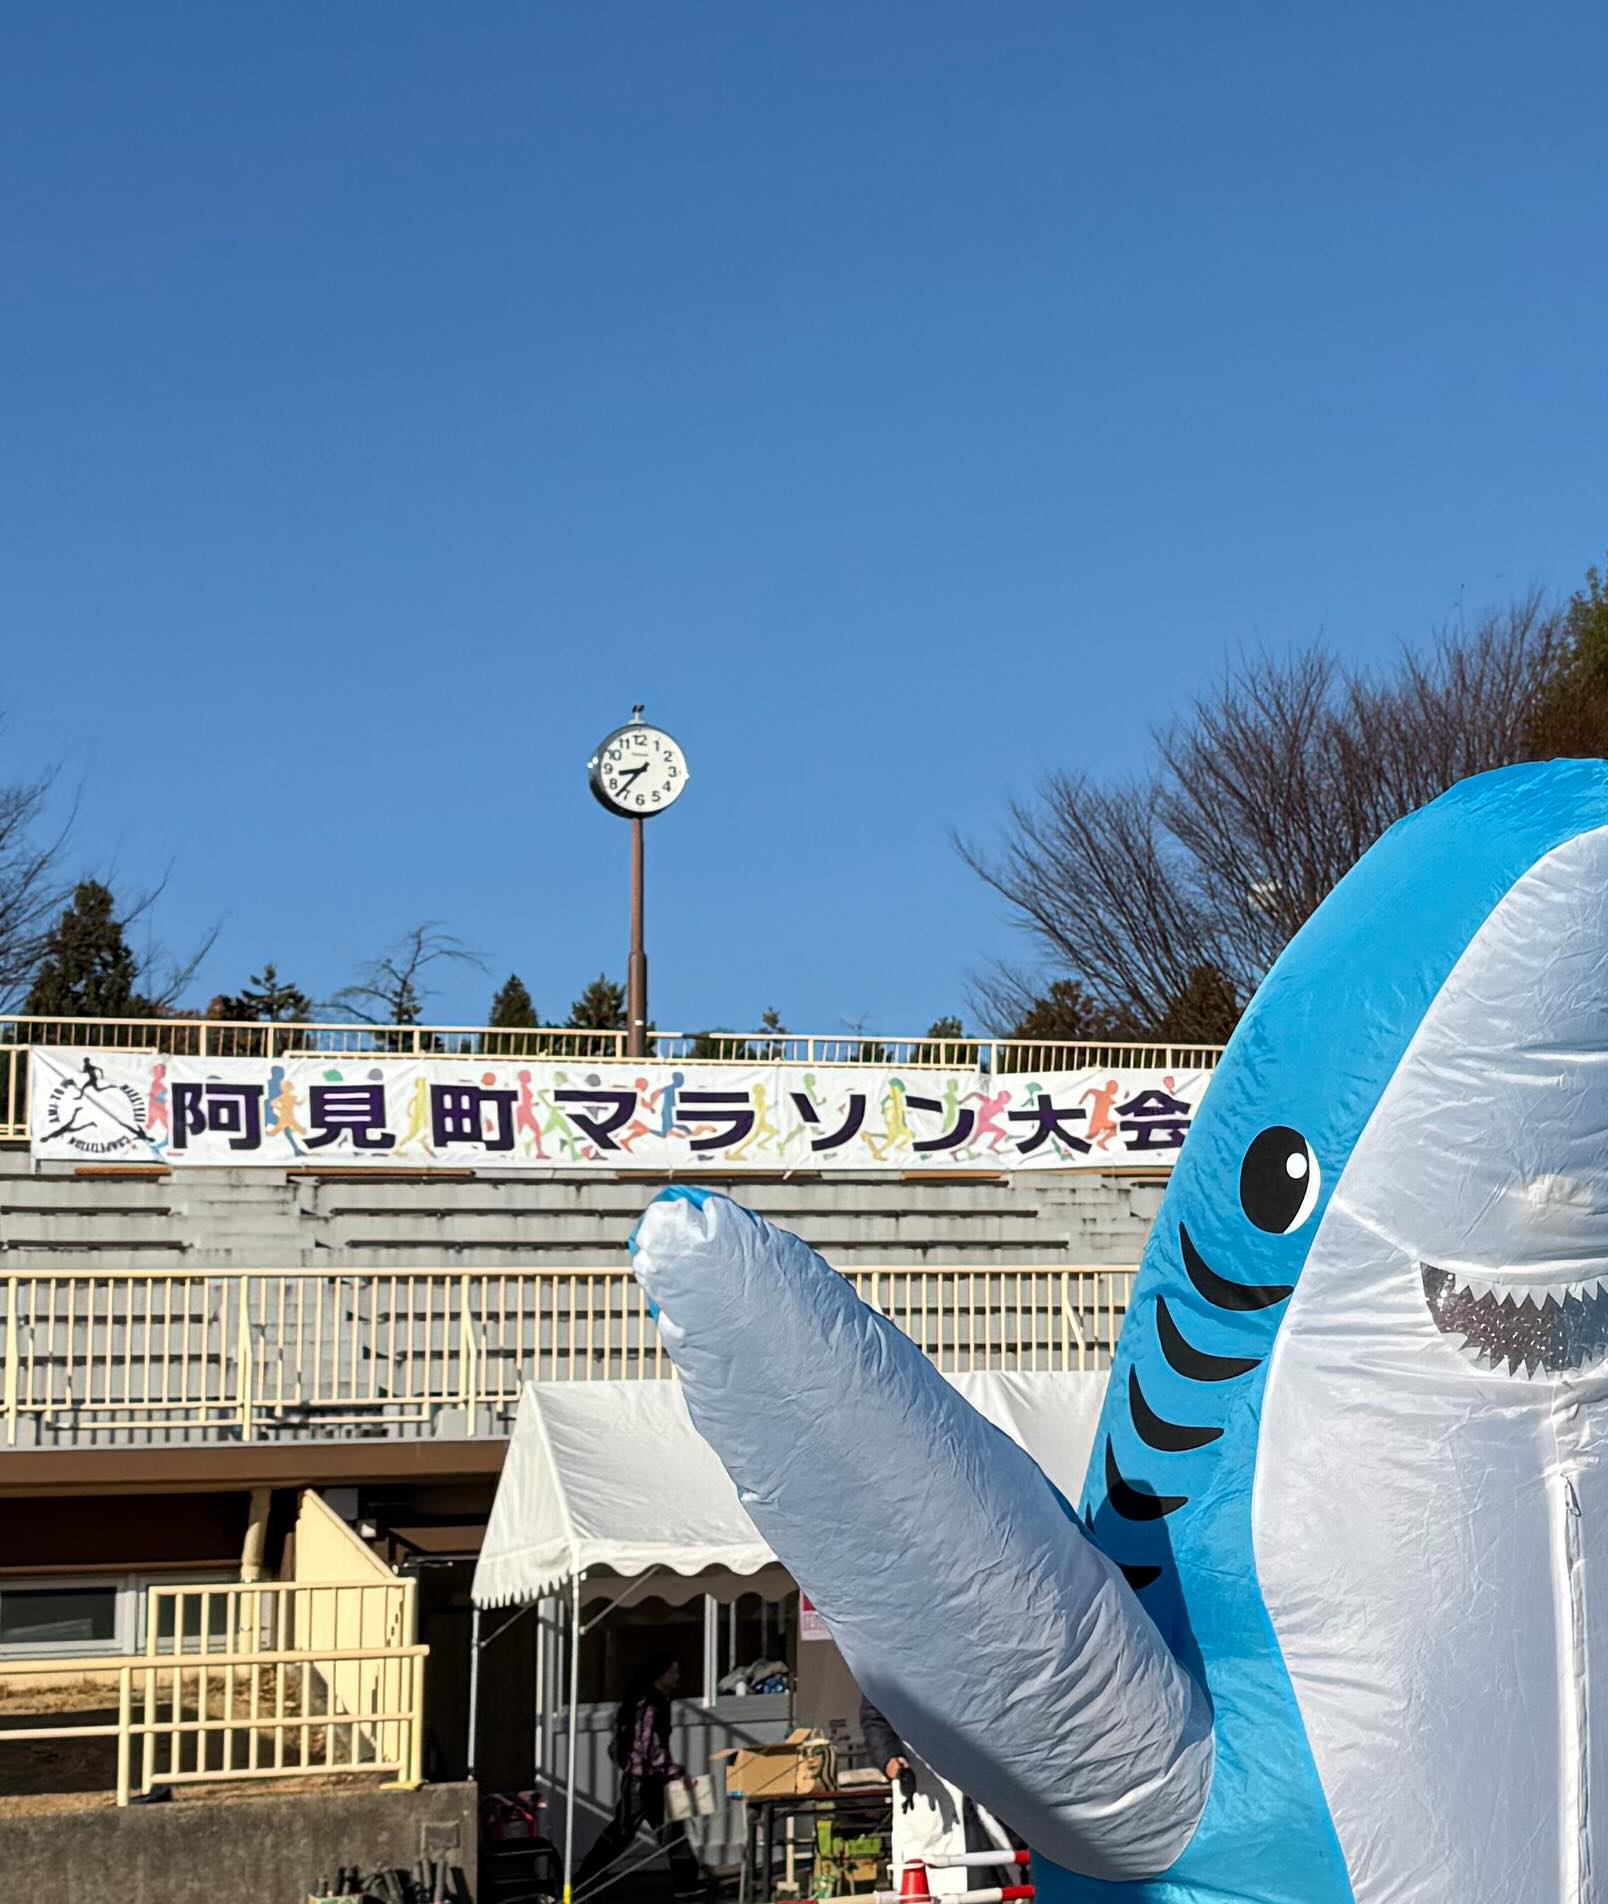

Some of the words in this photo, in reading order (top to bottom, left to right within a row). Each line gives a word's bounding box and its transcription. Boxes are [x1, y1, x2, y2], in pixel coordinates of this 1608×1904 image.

[619, 738, 630, 749] 11
[632, 734, 647, 746] 12
[654, 740, 660, 752] 1
[608, 749, 622, 761] 10
[663, 750, 673, 762] 2
[603, 762, 613, 774] 9
[668, 766, 677, 777] 3
[609, 778, 618, 790] 8
[662, 780, 671, 792] 4
[635, 794, 645, 806] 6
[651, 790, 661, 802] 5
[171, 1082, 1192, 1154] 阿見町マラソン大会
